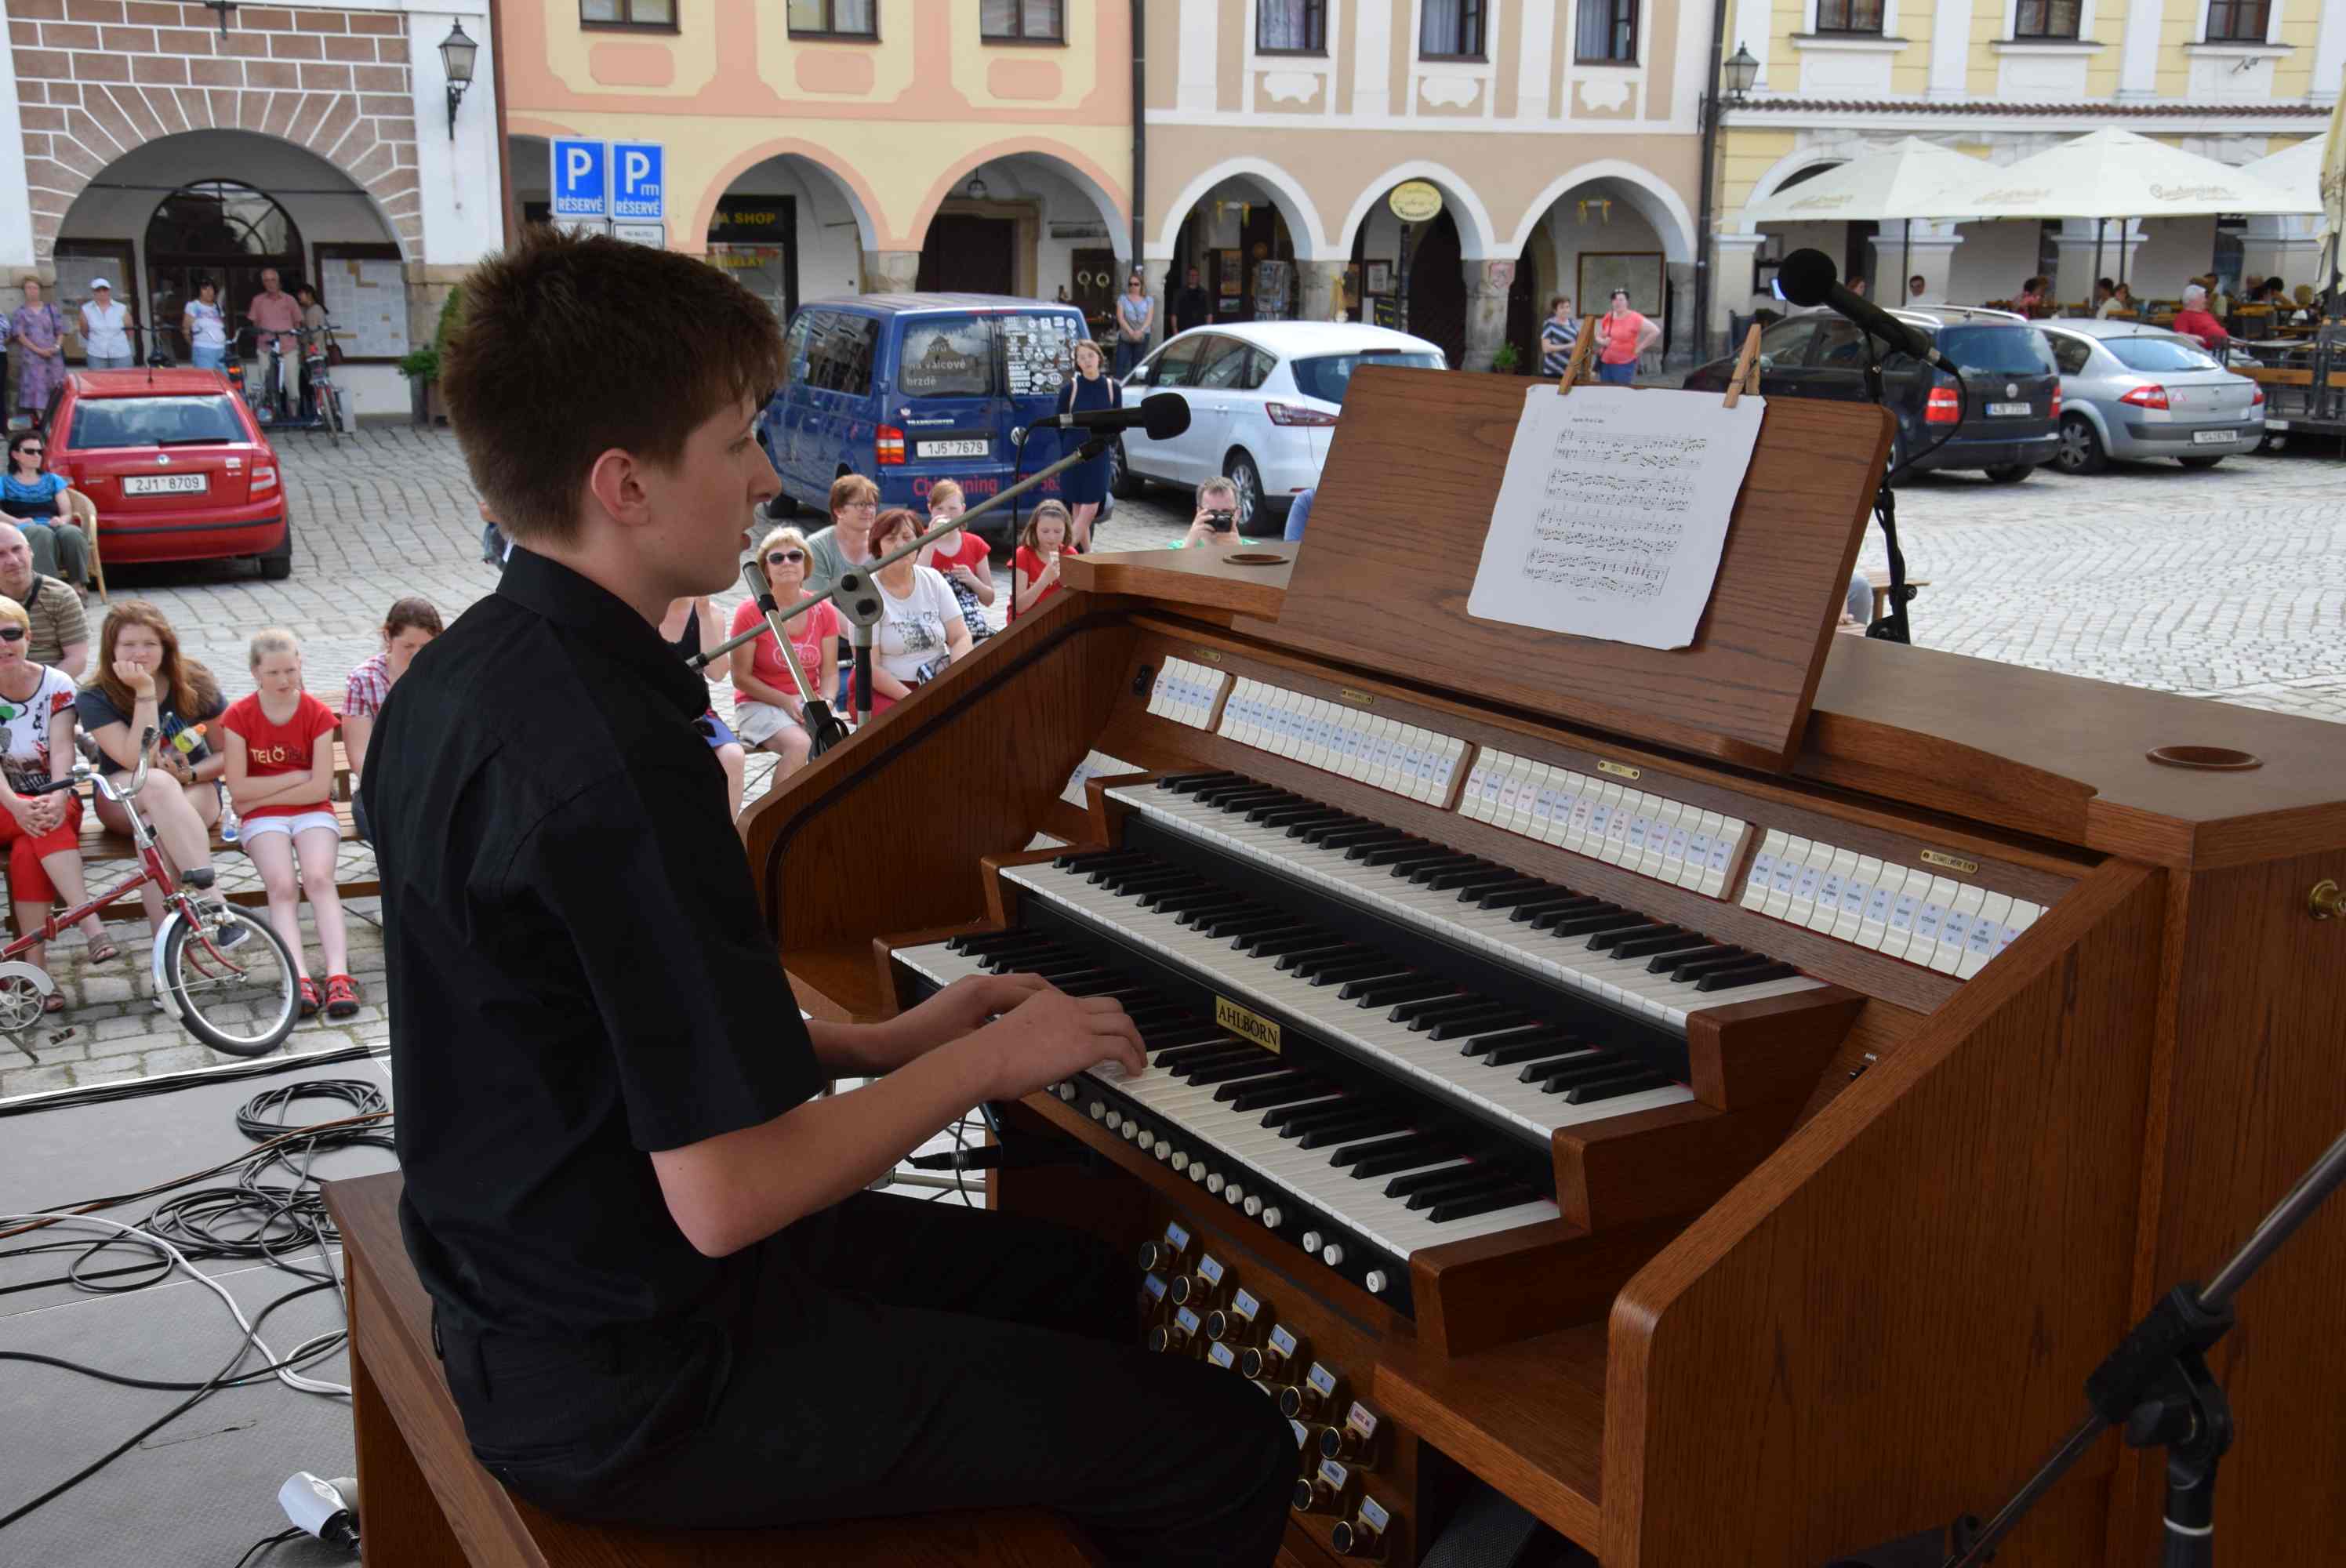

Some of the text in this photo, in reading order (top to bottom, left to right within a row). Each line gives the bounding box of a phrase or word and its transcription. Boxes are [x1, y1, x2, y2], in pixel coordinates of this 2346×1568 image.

[567, 147, 593, 191] P
[557, 195, 604, 212] RÉSERVÉ
[616, 198, 660, 216] RÉSERVÉ
[734, 212, 776, 225] SHOP
[928, 440, 983, 455] 1J5 7679
[135, 476, 200, 492] 2J1 8709
[1218, 1004, 1278, 1047] AHLBORN
